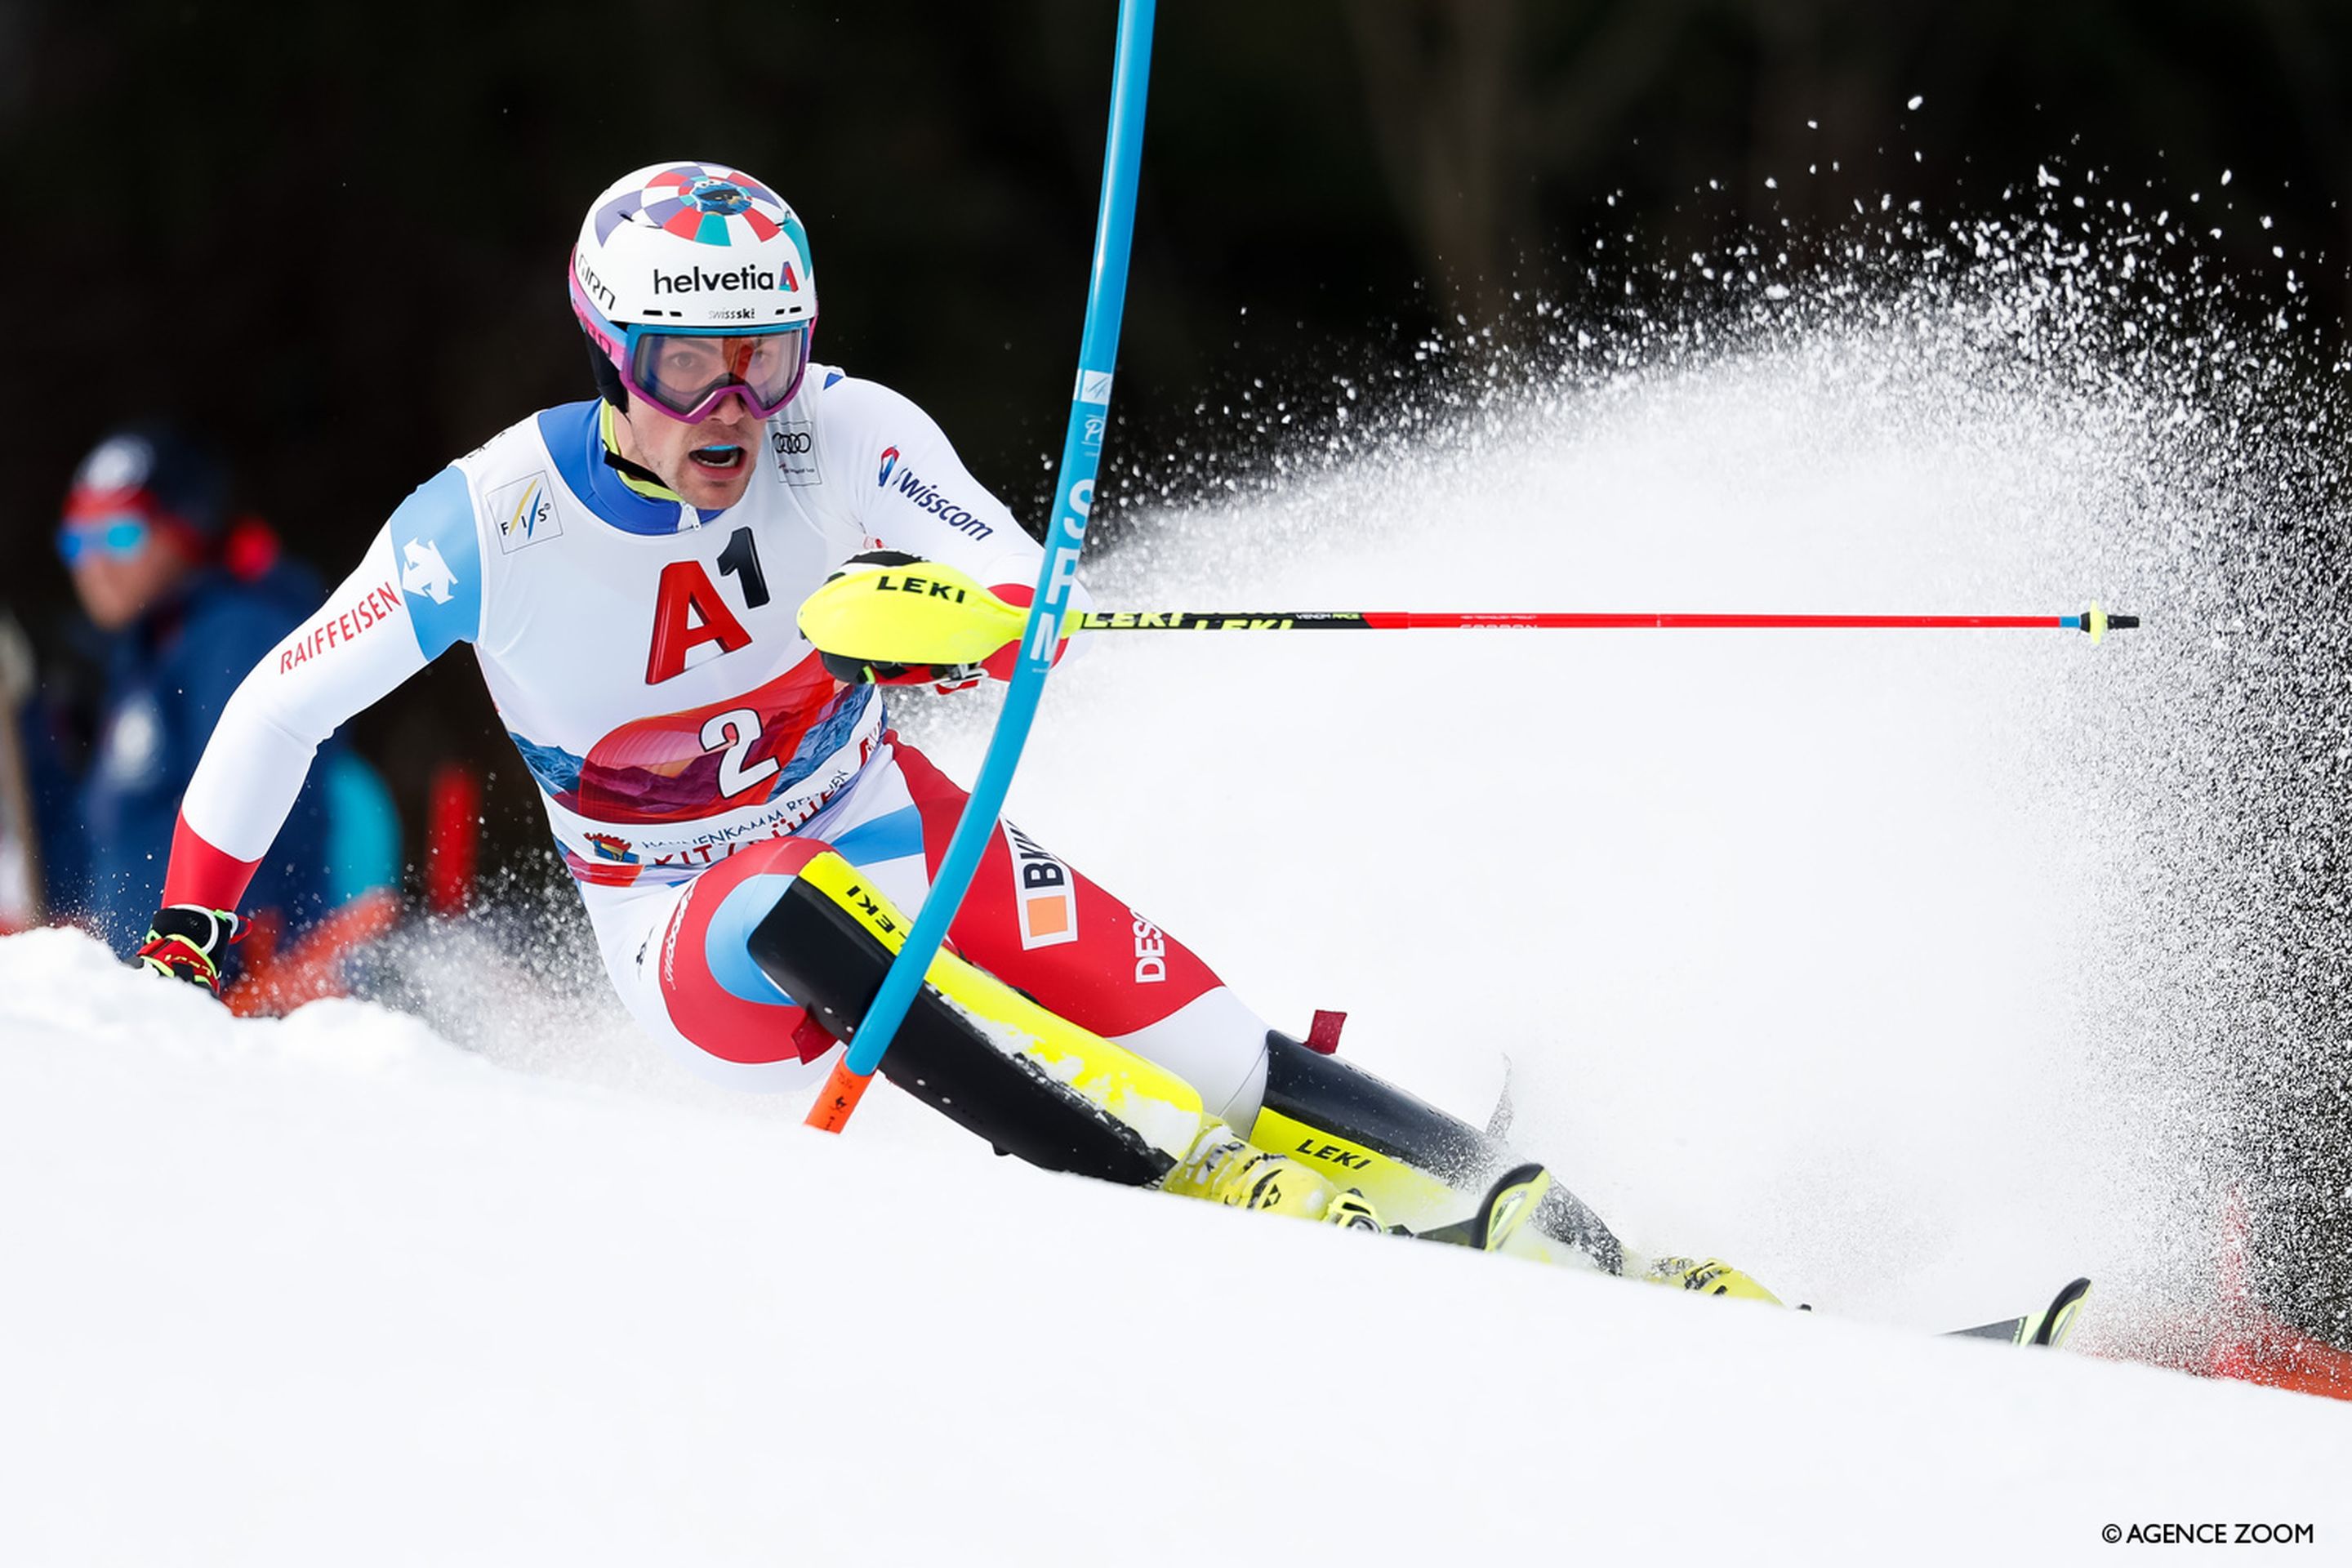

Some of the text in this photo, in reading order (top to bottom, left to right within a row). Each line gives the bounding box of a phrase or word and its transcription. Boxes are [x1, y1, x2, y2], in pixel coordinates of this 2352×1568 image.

[653, 264, 774, 295] helvetia
[645, 526, 770, 685] A1
[876, 576, 966, 604] LEKI
[279, 581, 403, 675] RAIFFEISEN
[1084, 612, 1183, 628] LEKI
[700, 707, 780, 800] 2
[1295, 1139, 1373, 1170] LEKI
